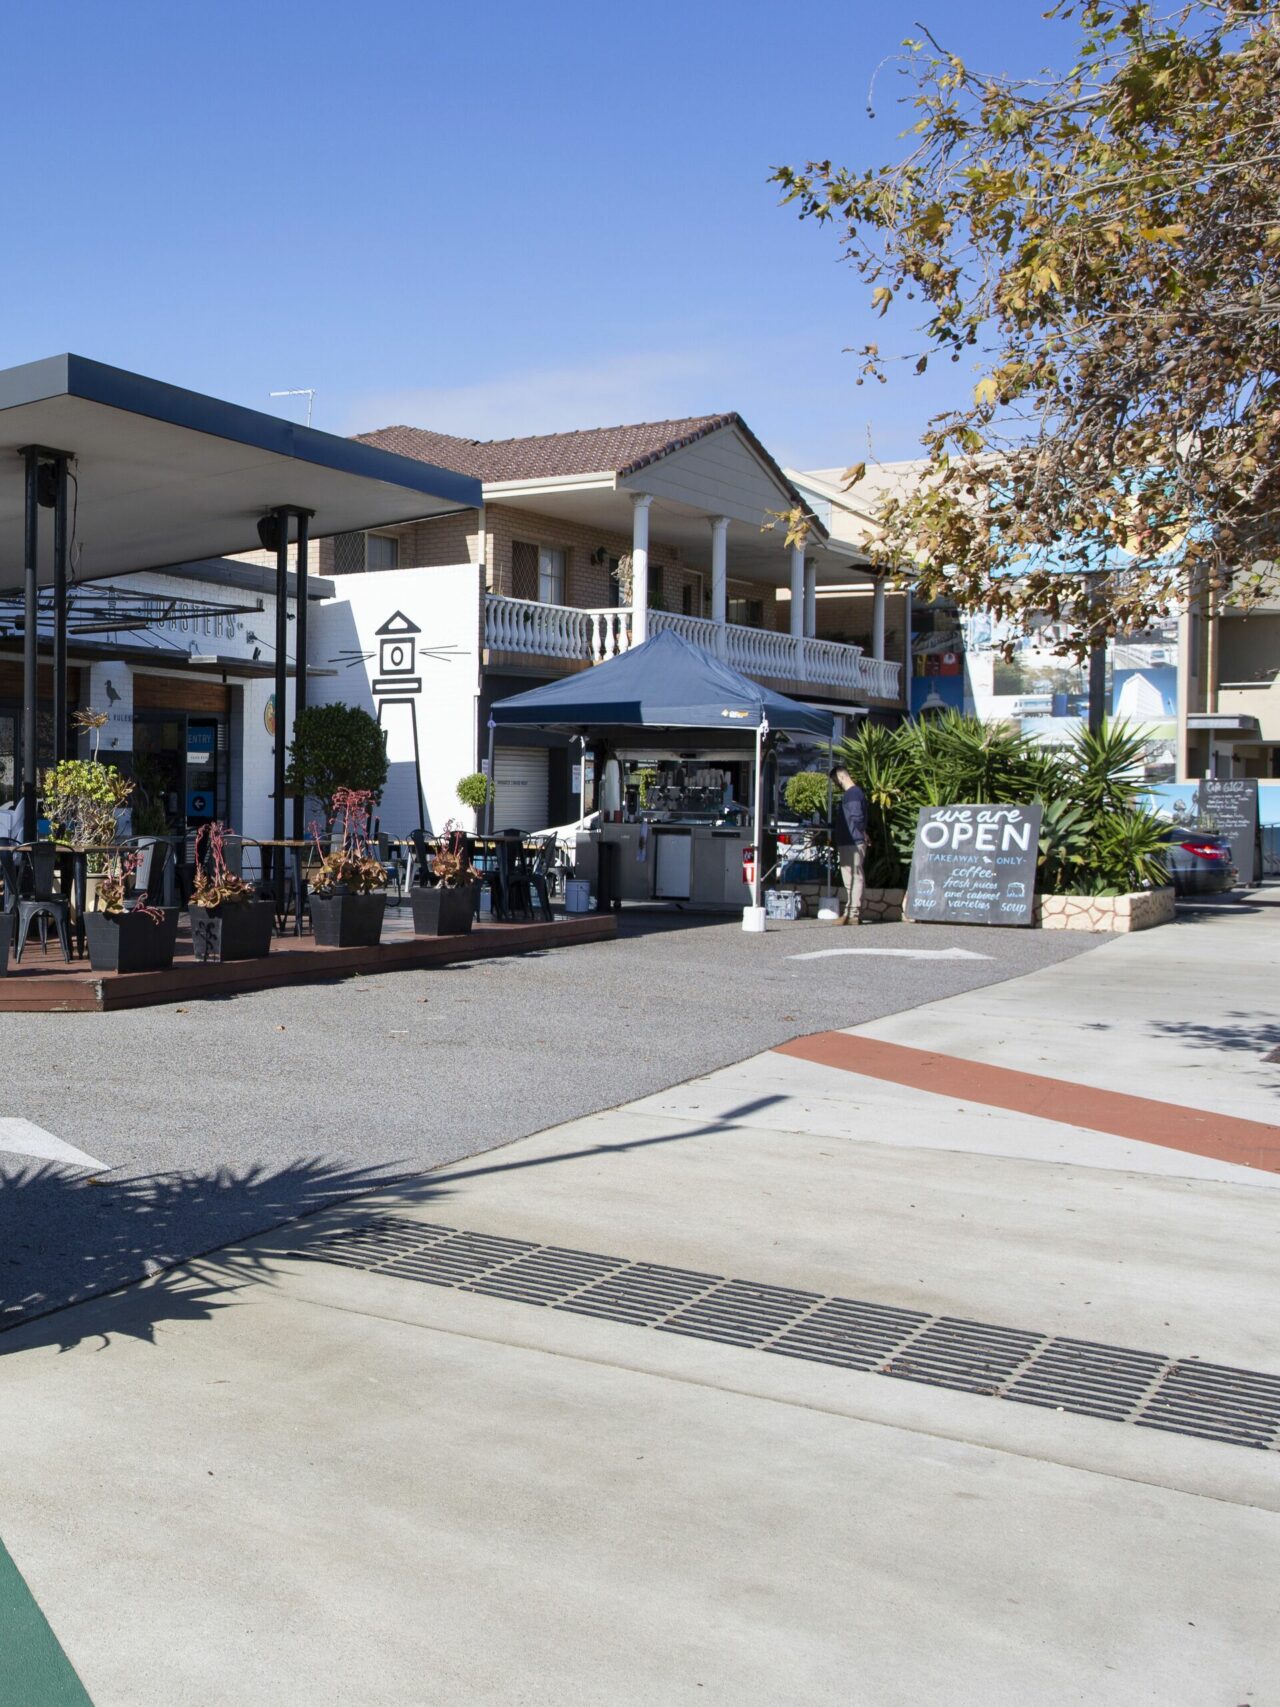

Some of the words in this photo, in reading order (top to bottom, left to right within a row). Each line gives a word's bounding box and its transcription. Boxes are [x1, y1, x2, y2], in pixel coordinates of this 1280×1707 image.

[187, 734, 212, 744] ENTRY
[931, 810, 973, 823] we
[976, 809, 1023, 823] are
[920, 821, 1031, 851] OPEN
[928, 853, 980, 864] TAKEAWAY
[951, 866, 992, 879] coffee
[943, 877, 970, 889] fresh
[970, 880, 998, 892] juices
[944, 890, 963, 898] and
[966, 890, 1001, 901] cabinet
[948, 899, 991, 911] varieties
